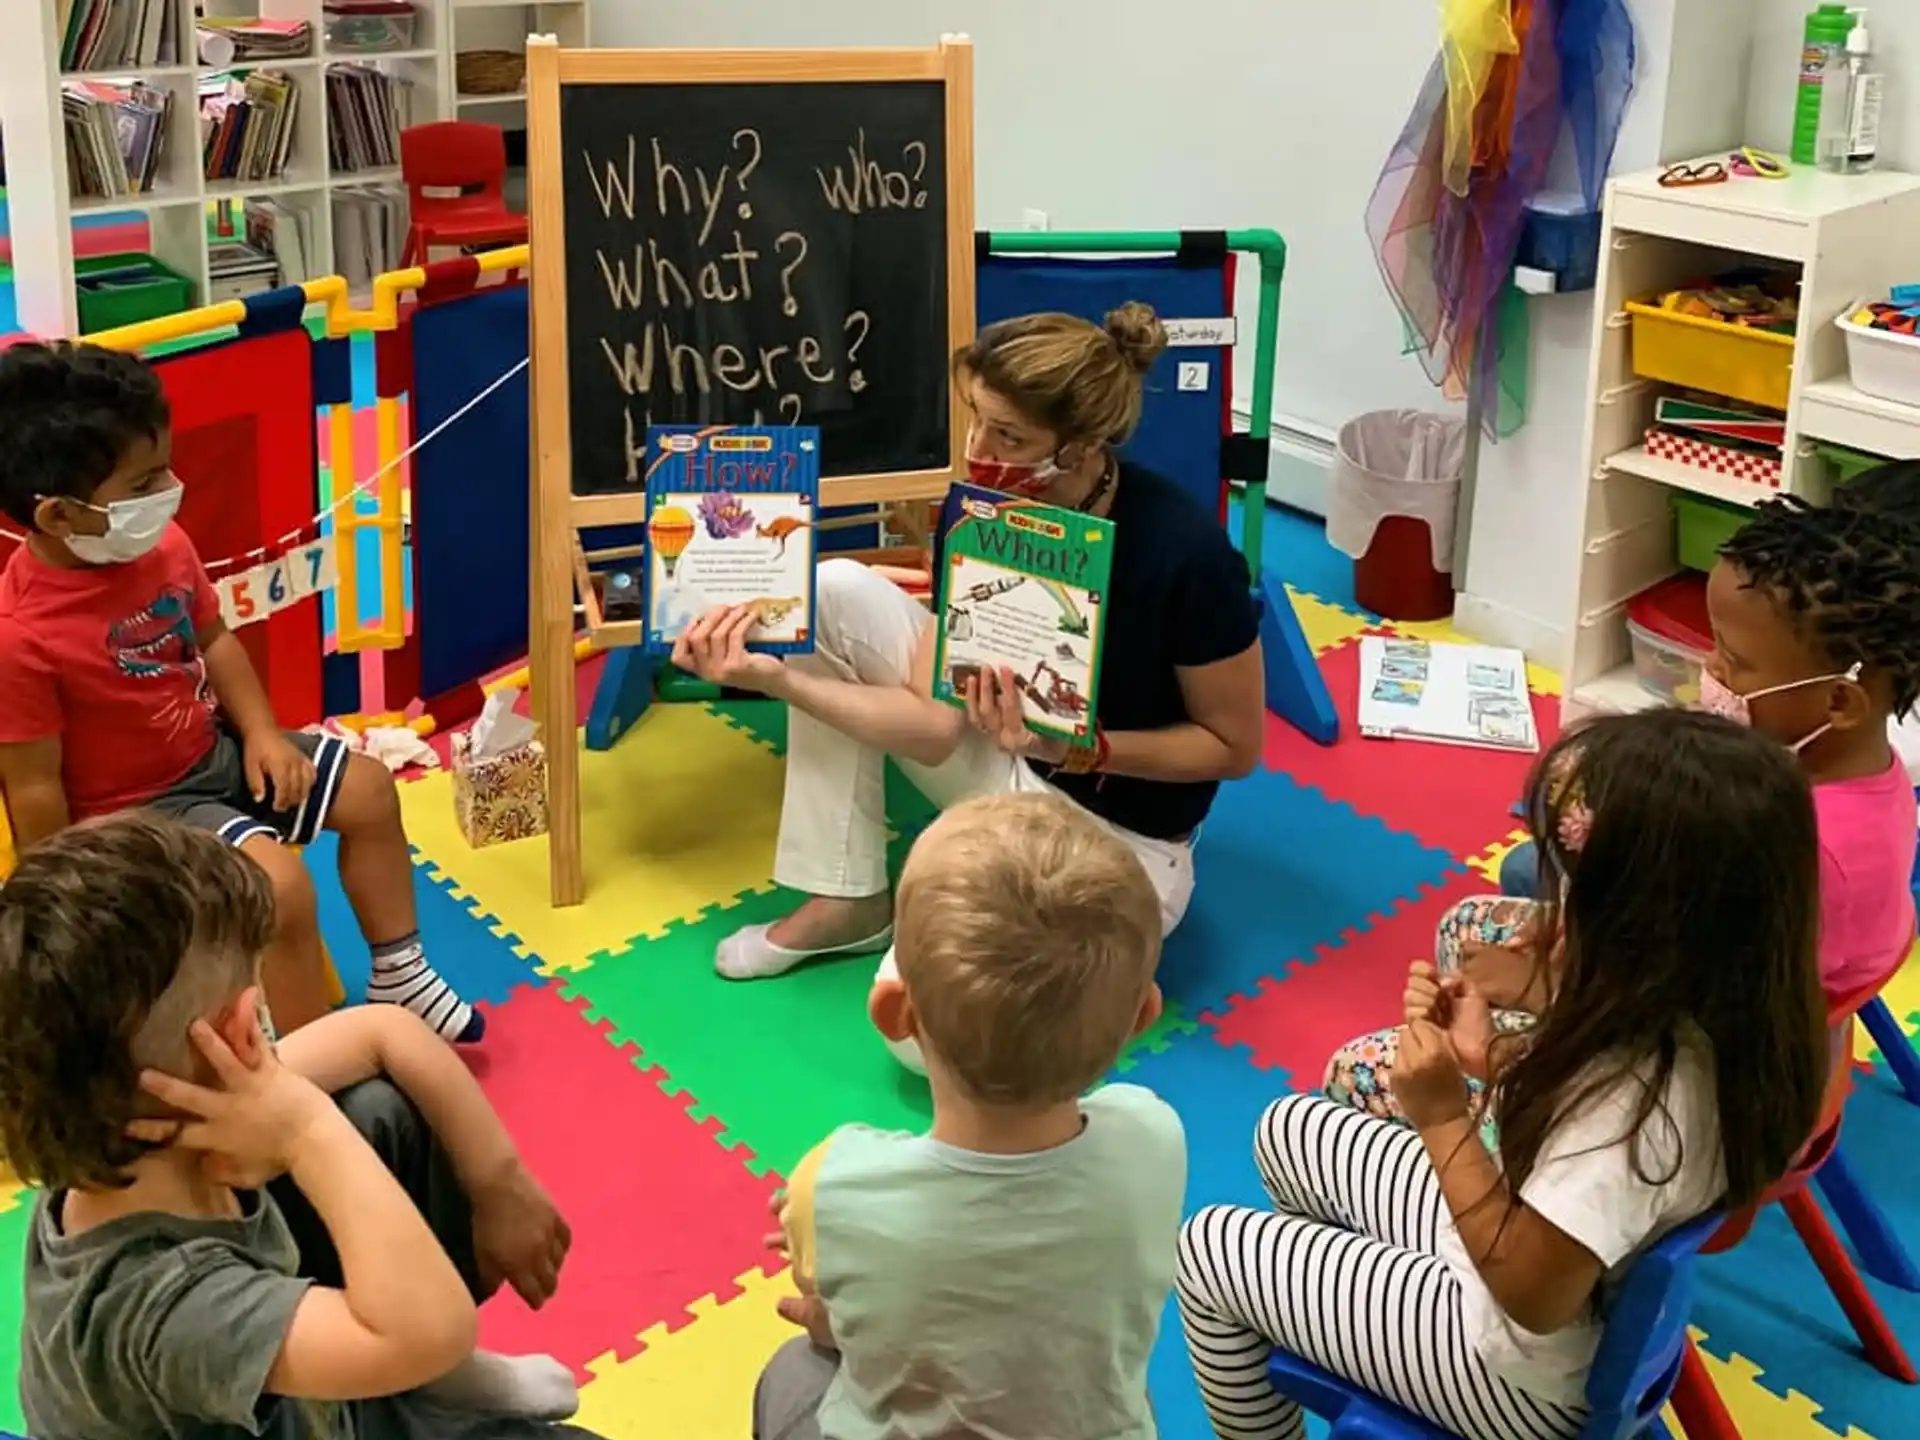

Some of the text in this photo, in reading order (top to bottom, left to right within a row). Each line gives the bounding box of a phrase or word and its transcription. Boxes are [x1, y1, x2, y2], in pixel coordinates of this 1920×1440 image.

[583, 129, 761, 246] Why?
[601, 311, 869, 393] Where?
[1165, 324, 1223, 341] aturday
[1184, 366, 1199, 388] 2
[682, 452, 796, 487] How?
[975, 522, 1089, 579] What?
[231, 548, 323, 617] 5 6 7
